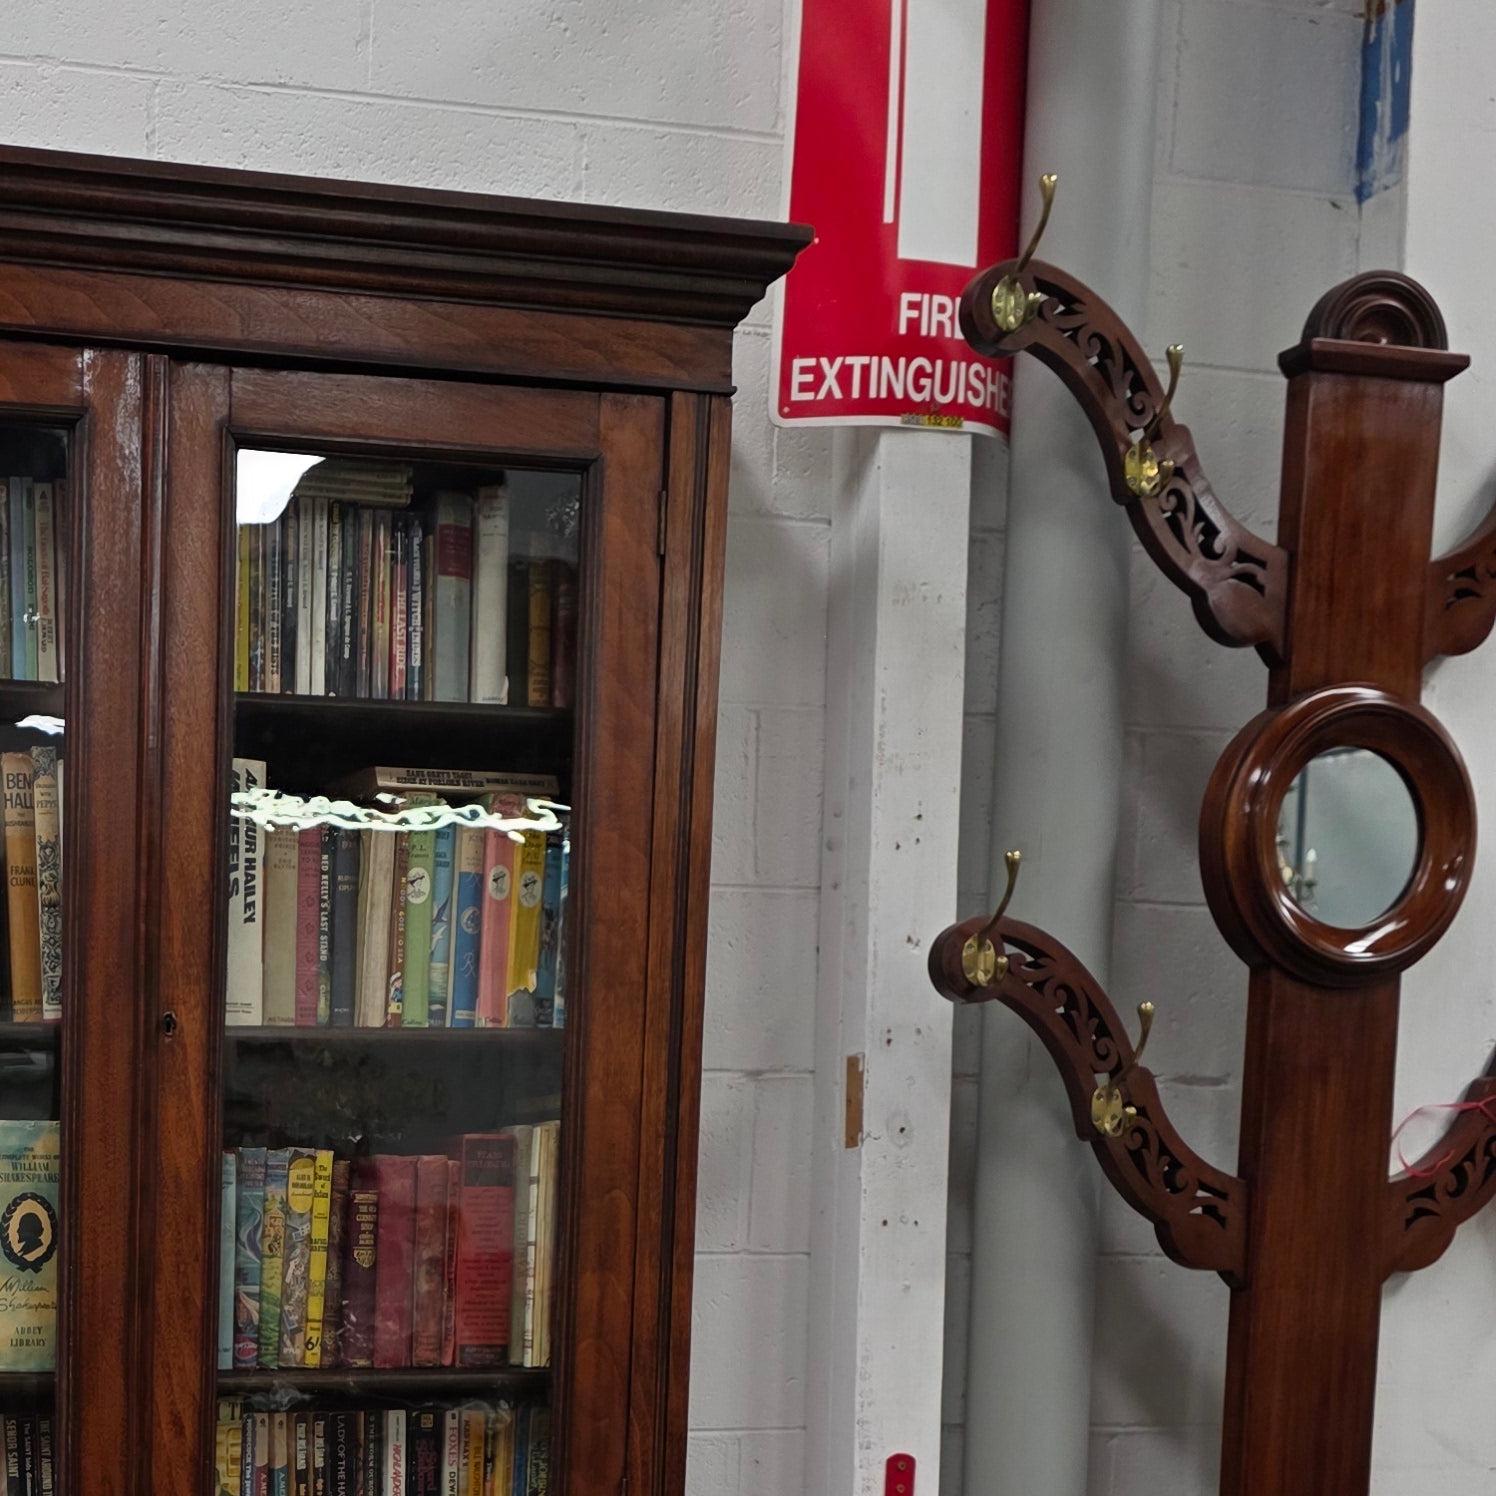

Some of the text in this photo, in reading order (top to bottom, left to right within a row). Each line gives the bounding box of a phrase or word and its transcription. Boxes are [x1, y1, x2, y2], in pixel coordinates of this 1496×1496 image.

[790, 356, 1010, 417] EXTINGUISHE
[397, 591, 406, 670] THE LAST RIDE
[7, 773, 31, 789] BEN
[4, 793, 34, 809] HALL
[10, 866, 36, 875] FRANK
[10, 877, 36, 887] CLUNE
[244, 857, 256, 923] HAILEY
[320, 854, 328, 961] NED KELLY'S LAST STAND
[11, 1162, 49, 1172] WILLIAM
[15, 1326, 43, 1335] ABBEY
[10, 1338, 47, 1347] LIBRARY
[40, 1421, 50, 1434] THE
[337, 1416, 345, 1443] LADY
[41, 1436, 51, 1456] SAINT
[338, 1444, 345, 1458] OF
[448, 1427, 457, 1467] FOXES
[8, 1452, 19, 1478] SAINT
[42, 1458, 53, 1490] AROUND
[337, 1460, 345, 1480] THE
[473, 1461, 481, 1496] NAUGHTON
